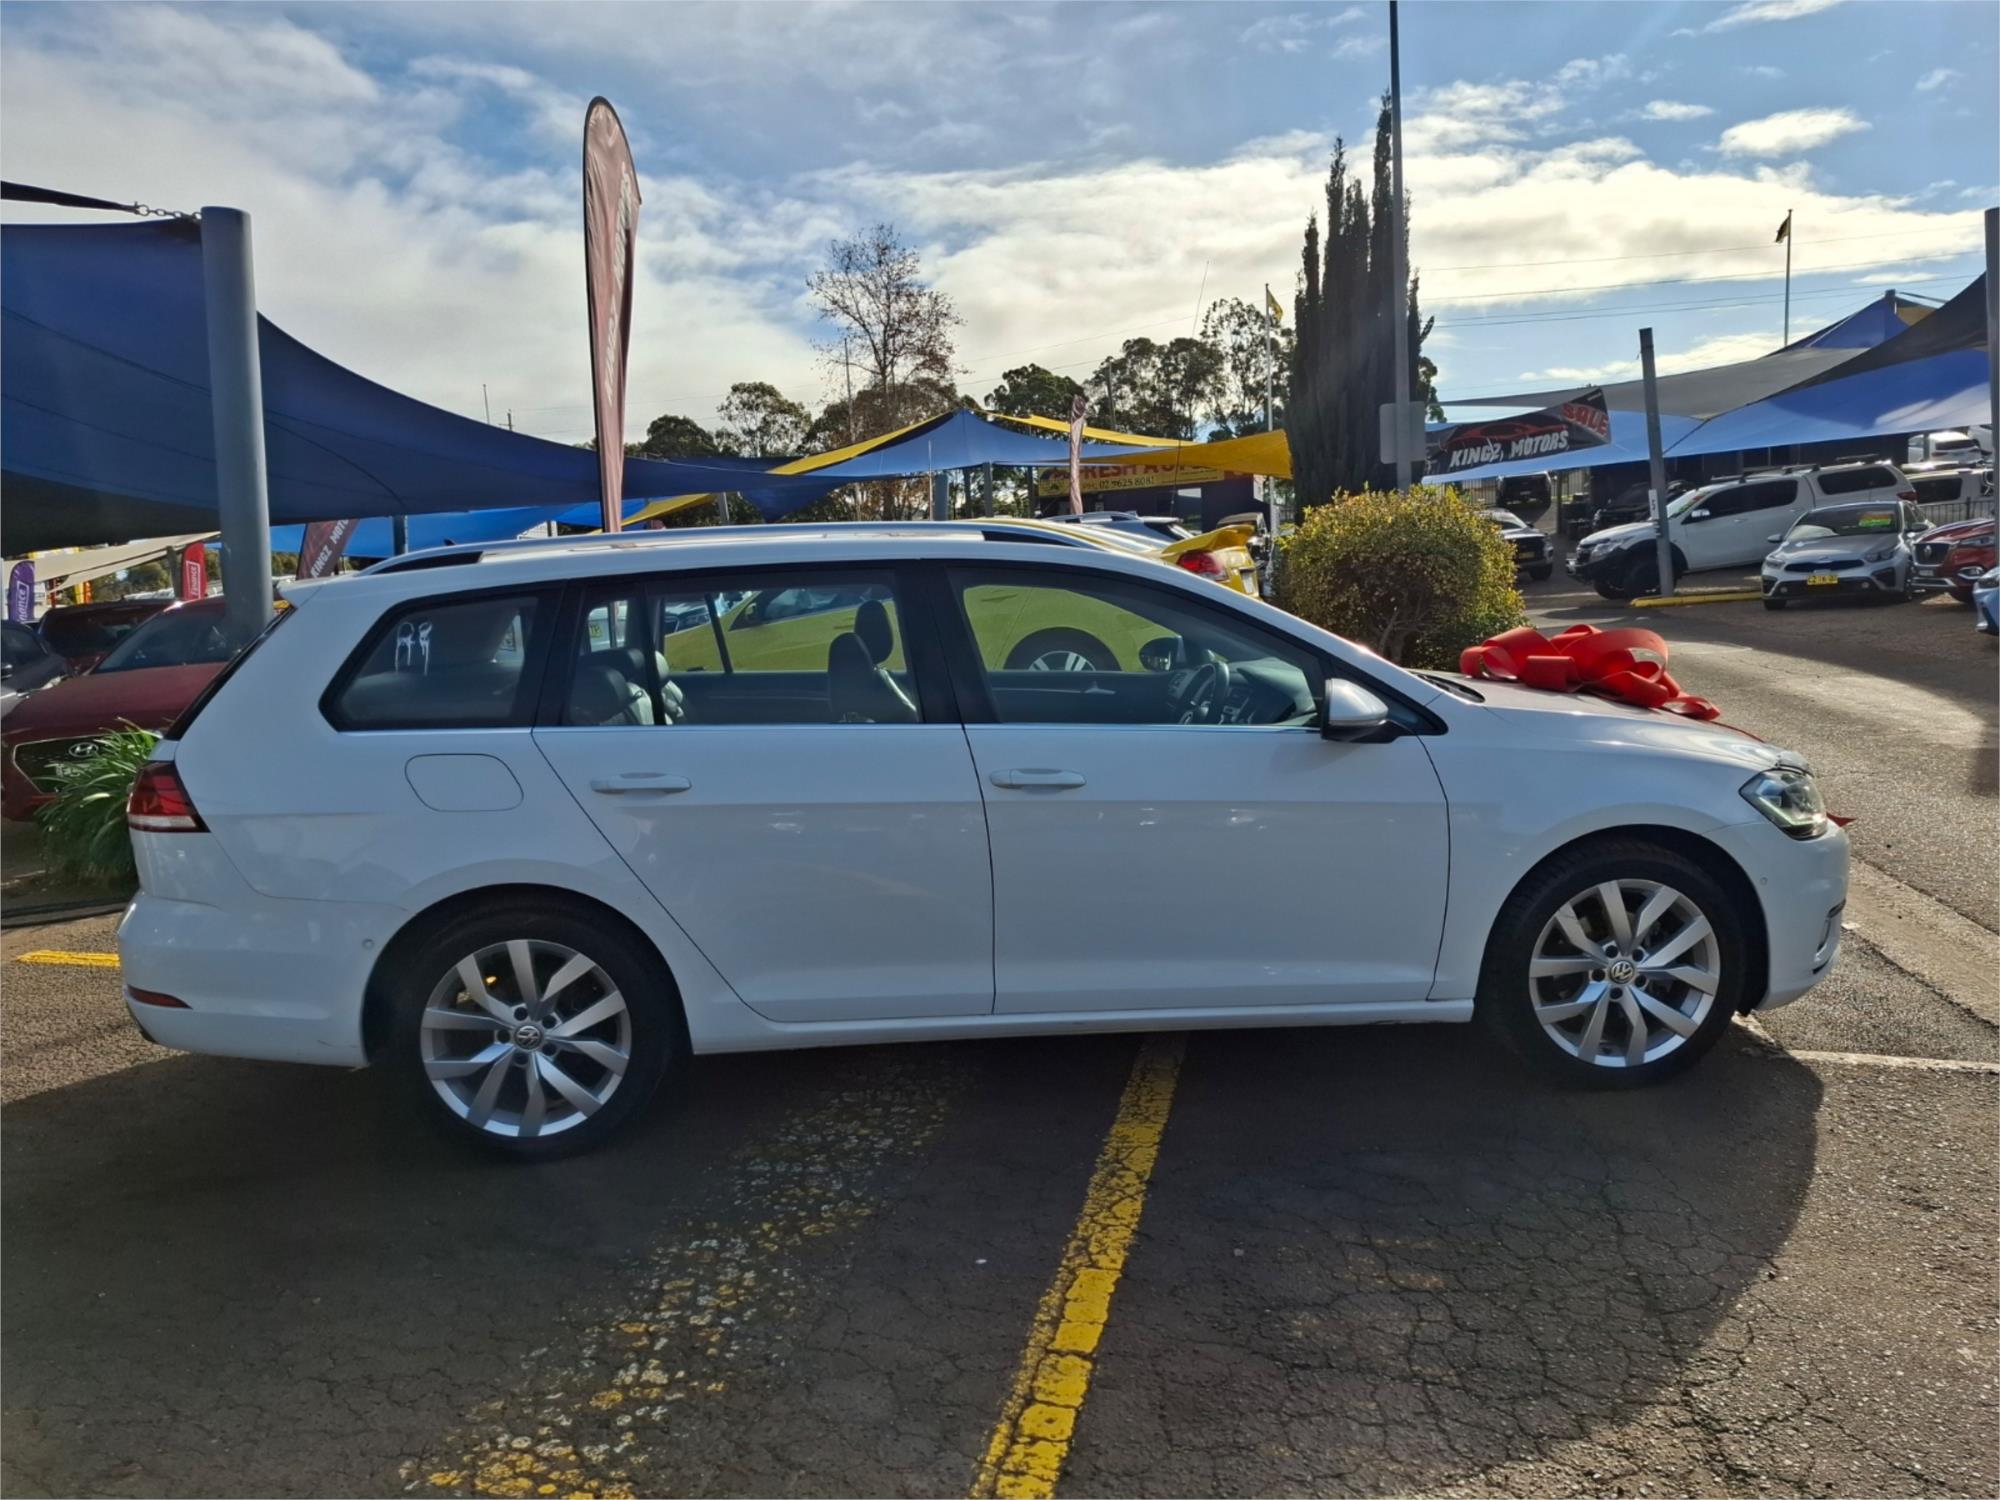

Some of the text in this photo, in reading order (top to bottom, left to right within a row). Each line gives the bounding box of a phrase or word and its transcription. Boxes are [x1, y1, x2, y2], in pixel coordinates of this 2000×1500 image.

[1562, 402, 1609, 437] SALE
[1509, 430, 1569, 460] MOTORS
[1079, 464, 1137, 479] RESH
[311, 545, 333, 579] KINGZ
